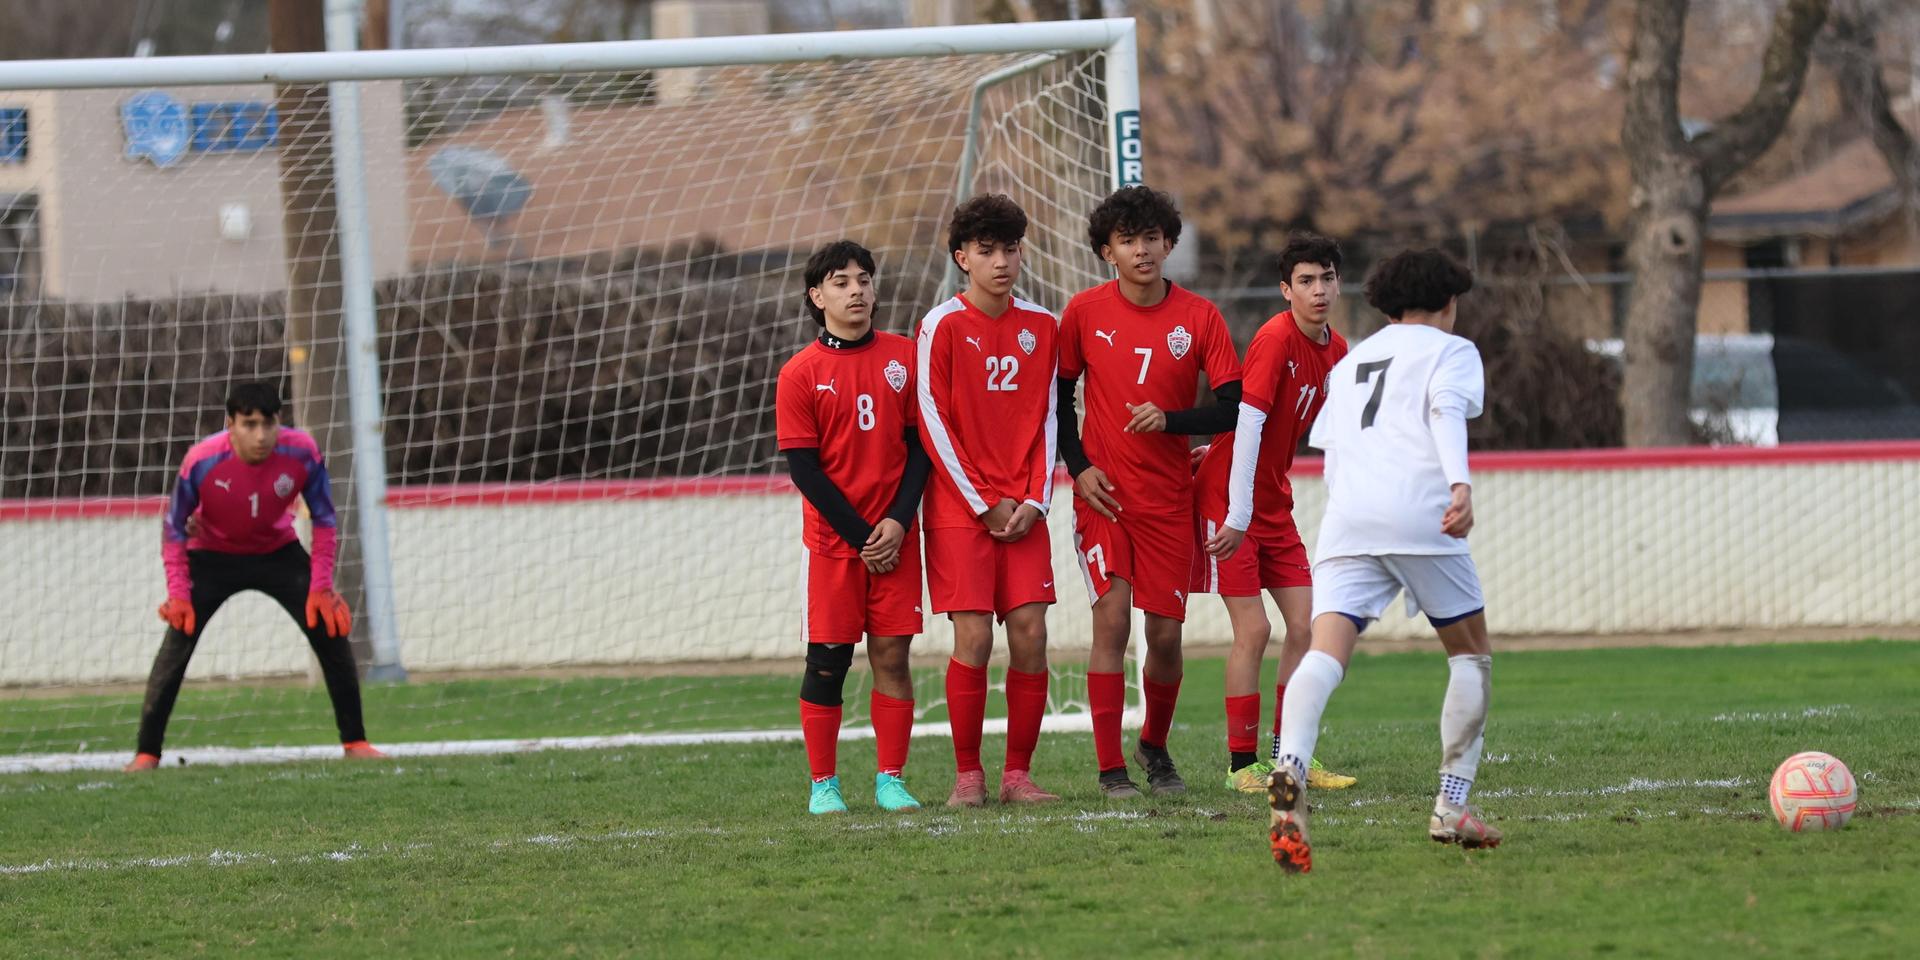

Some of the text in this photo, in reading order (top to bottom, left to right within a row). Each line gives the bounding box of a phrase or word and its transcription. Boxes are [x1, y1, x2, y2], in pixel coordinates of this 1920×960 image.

[1121, 116, 1143, 189] FOR
[985, 356, 1019, 391] 22
[1134, 347, 1152, 385] 7
[856, 393, 876, 431] 8
[1294, 383, 1317, 420] 11
[1356, 356, 1394, 431] 7
[248, 492, 259, 518] 1
[1086, 543, 1108, 581] 7
